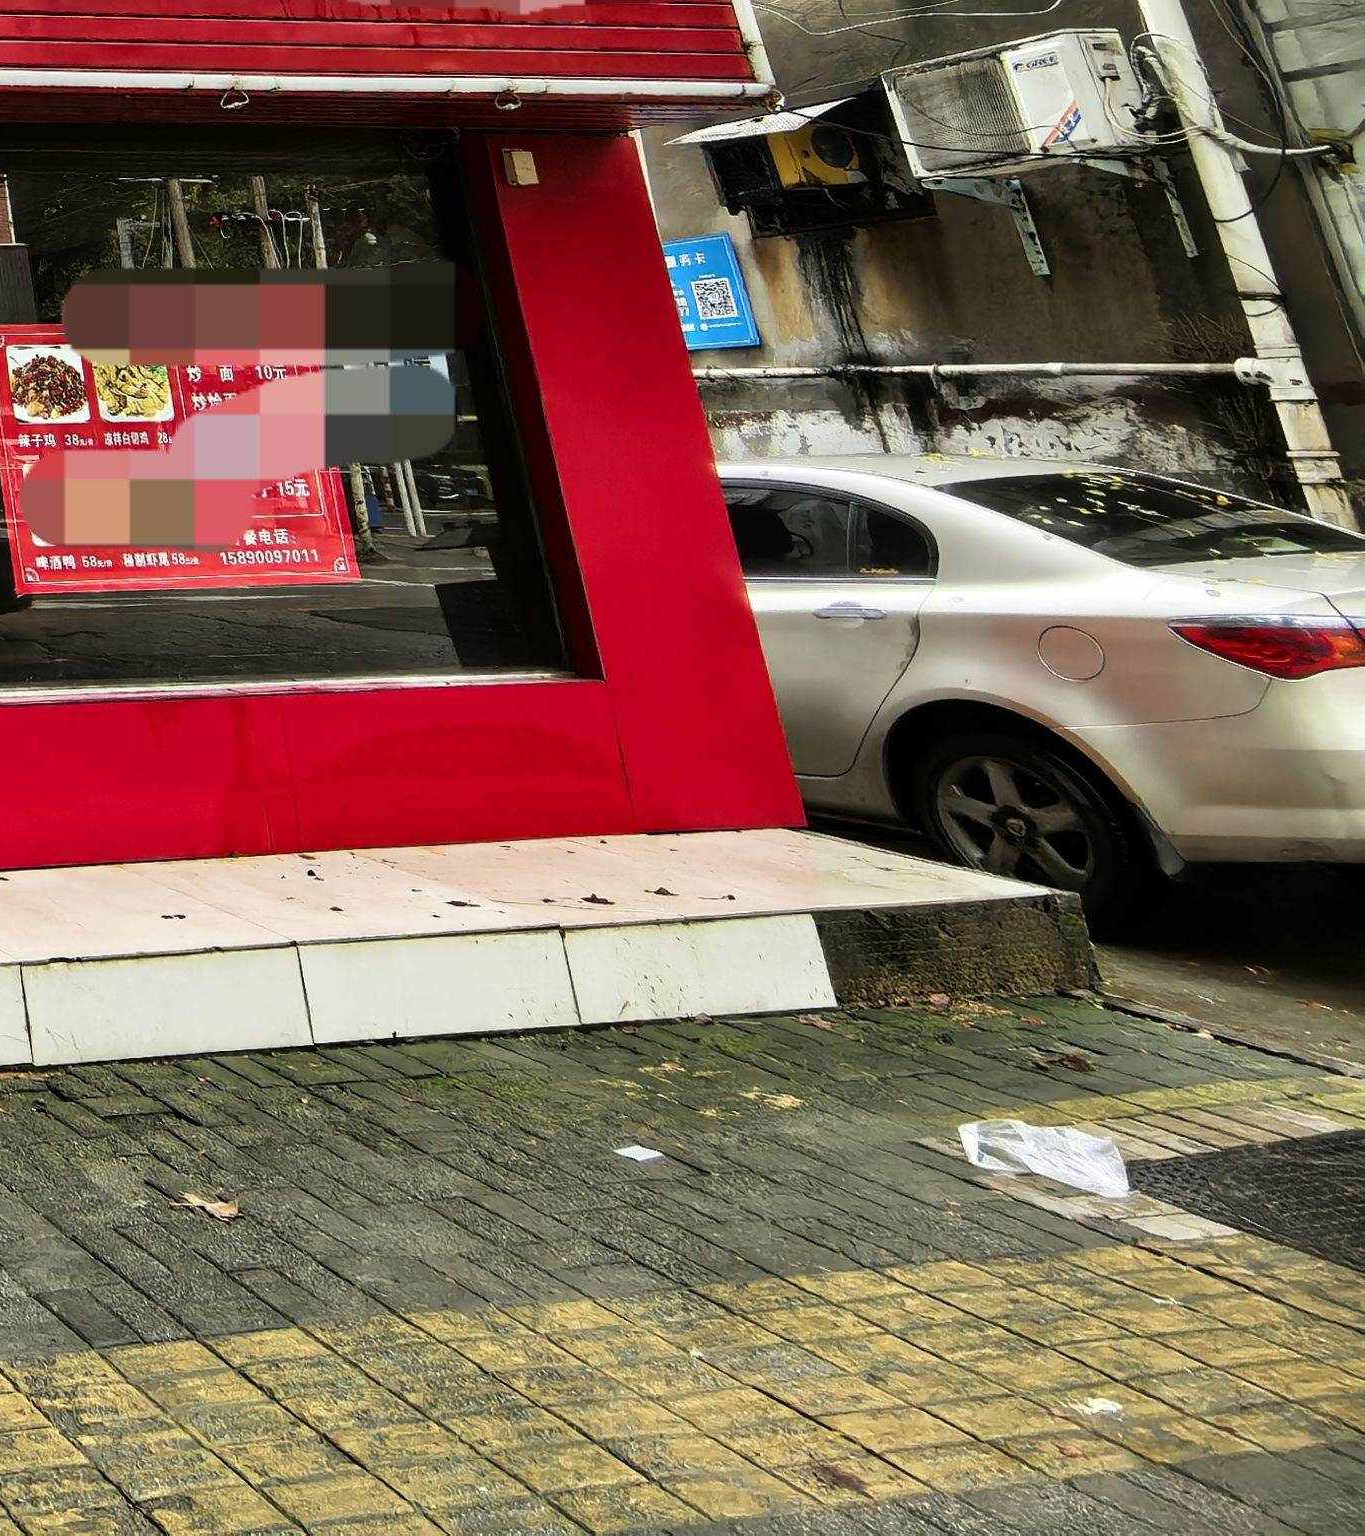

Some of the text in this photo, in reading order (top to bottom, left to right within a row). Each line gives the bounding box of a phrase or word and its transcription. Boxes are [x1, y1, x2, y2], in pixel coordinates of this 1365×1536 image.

[18, 432, 57, 449] 辣子鸡
[276, 479, 311, 498] 15元
[234, 528, 298, 547] 餐电话：
[219, 548, 320, 566] 15890097011
